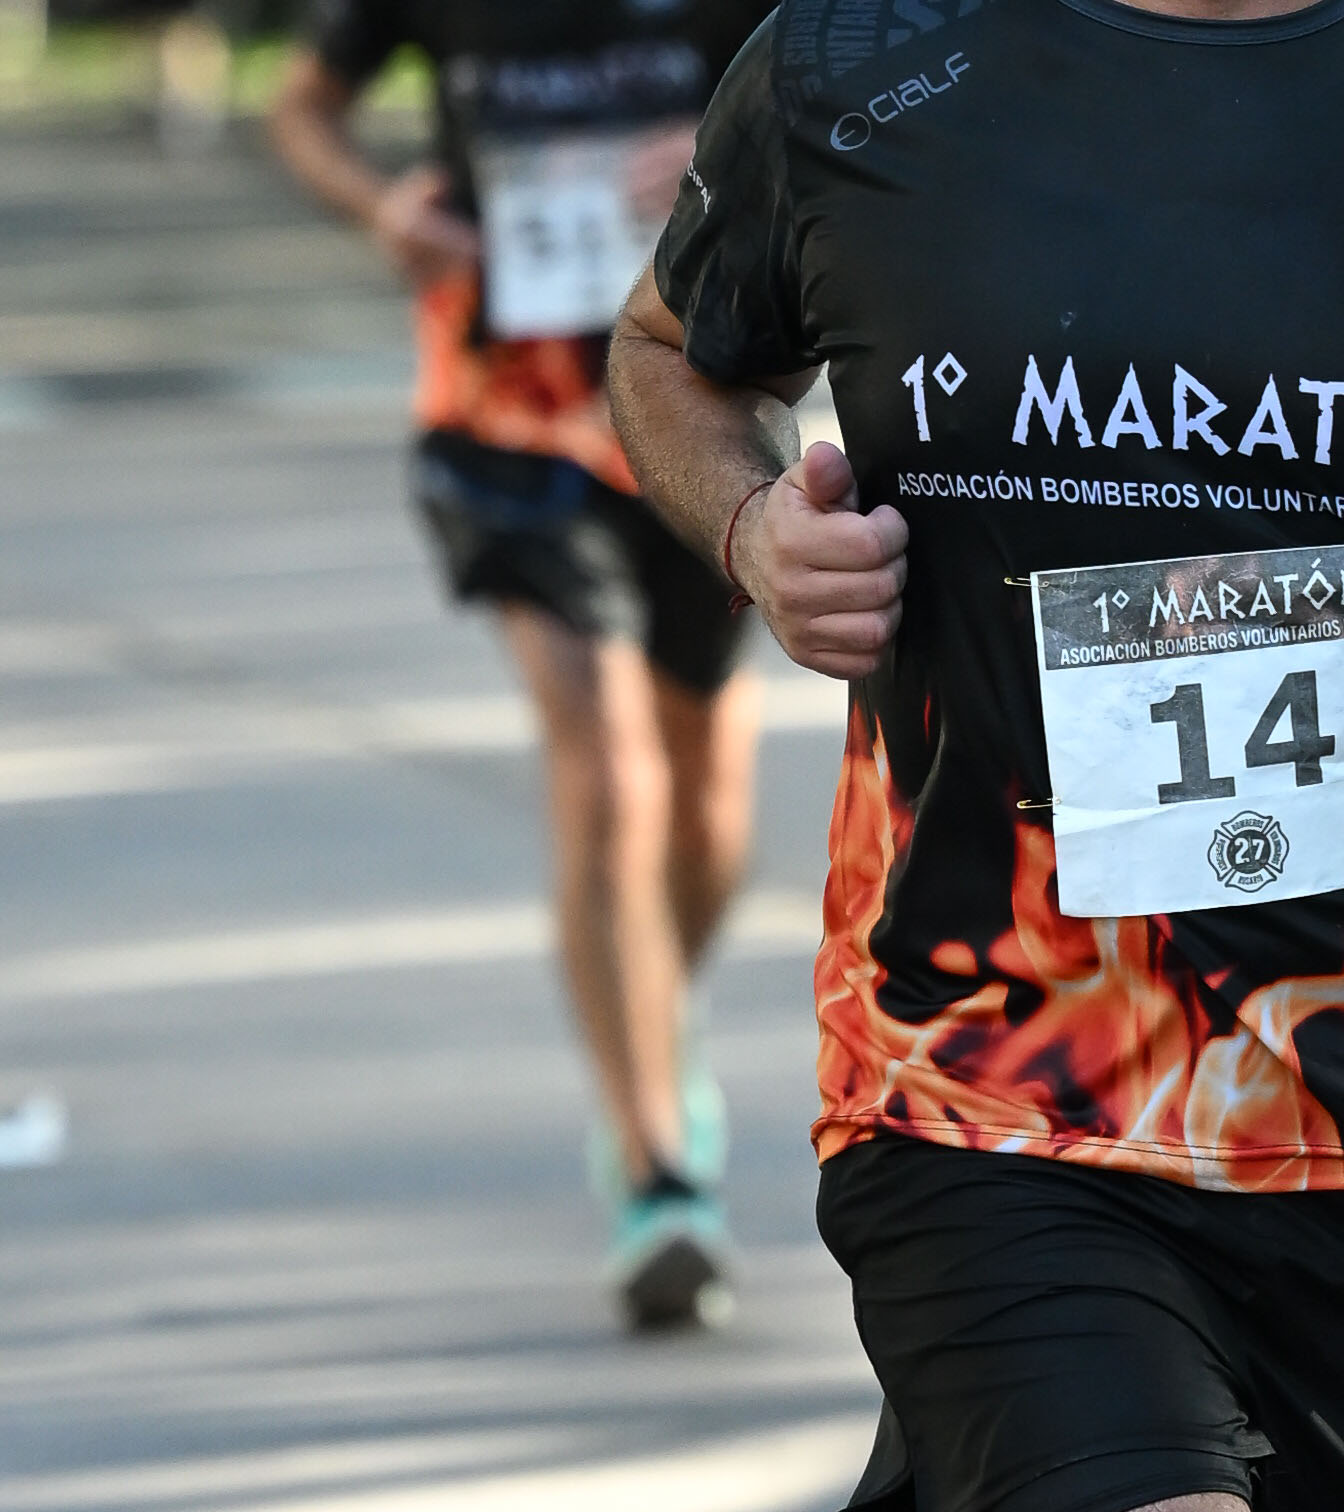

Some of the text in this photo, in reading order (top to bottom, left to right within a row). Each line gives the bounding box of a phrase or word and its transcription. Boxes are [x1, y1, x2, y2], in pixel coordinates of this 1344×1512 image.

[898, 468, 1034, 501] ASOCIACIÓN
[1043, 475, 1200, 509] BOMBEROS
[1060, 636, 1151, 666] ASOCIACIÓN
[1155, 627, 1238, 657] BOMBEROS
[1240, 619, 1341, 648] VOLUNTARIOS
[1149, 669, 1336, 805] 14
[1234, 837, 1265, 865] 27
